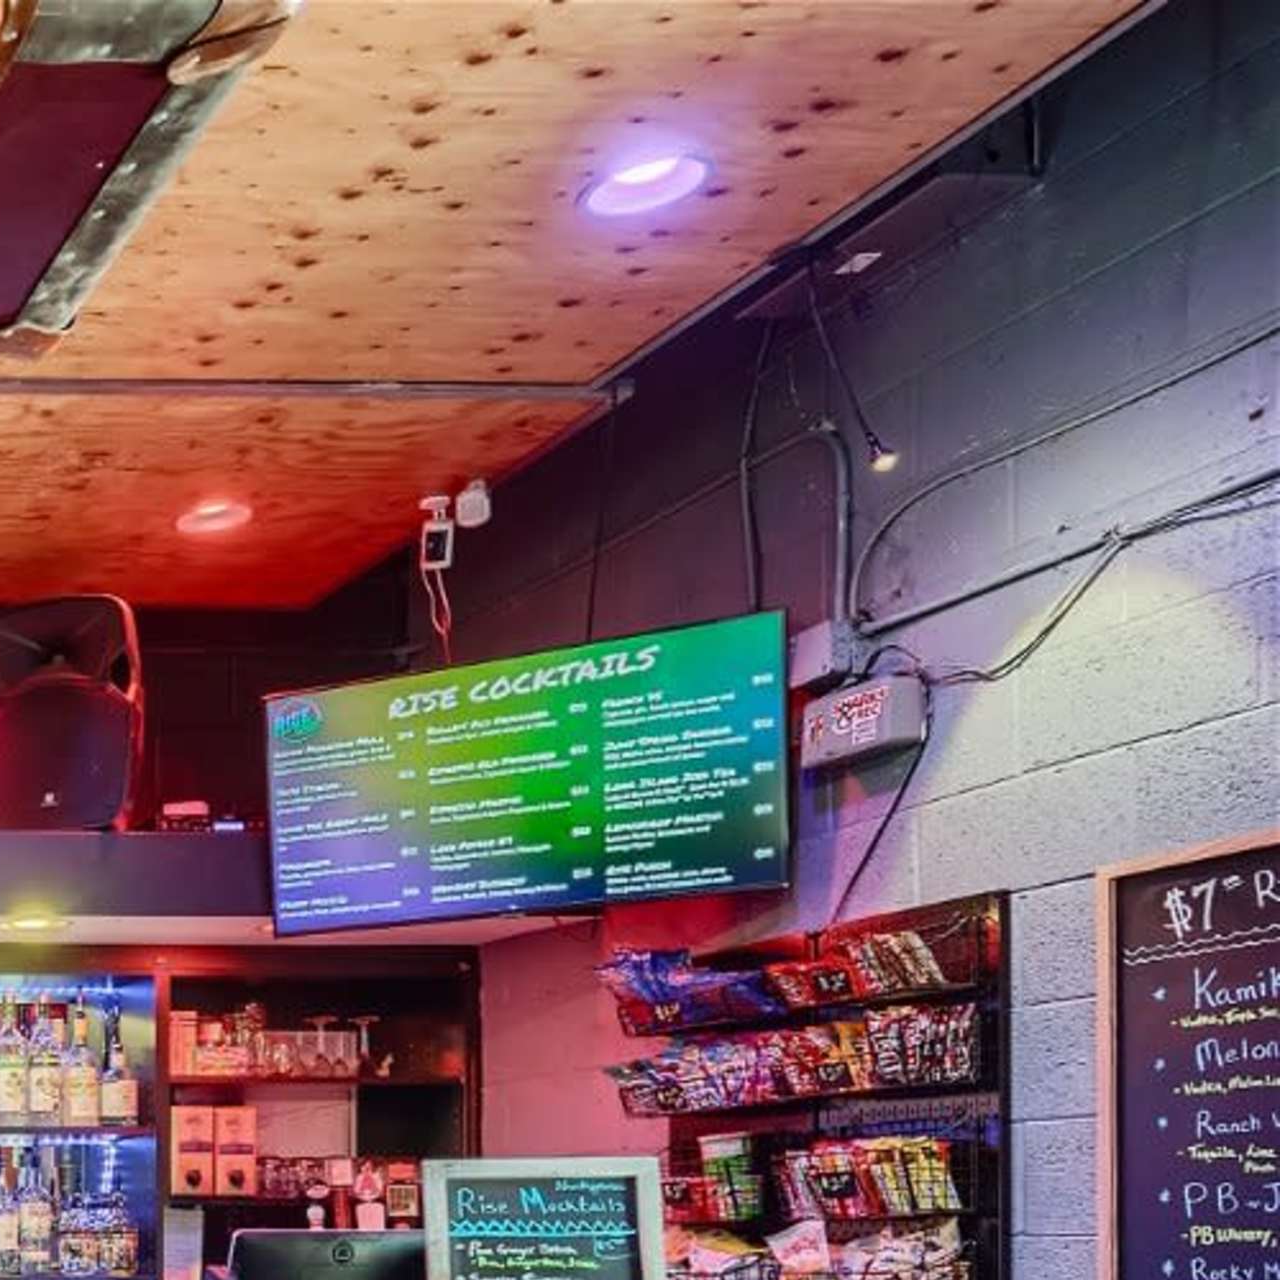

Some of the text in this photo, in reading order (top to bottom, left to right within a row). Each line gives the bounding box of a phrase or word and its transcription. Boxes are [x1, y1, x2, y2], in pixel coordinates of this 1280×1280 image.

[388, 645, 661, 719] RISE COCKTAILS
[1195, 1038, 1279, 1072] Melon
[1197, 1110, 1262, 1139] Ranch
[456, 1187, 509, 1218] Rise
[519, 1187, 627, 1215] Mocktails
